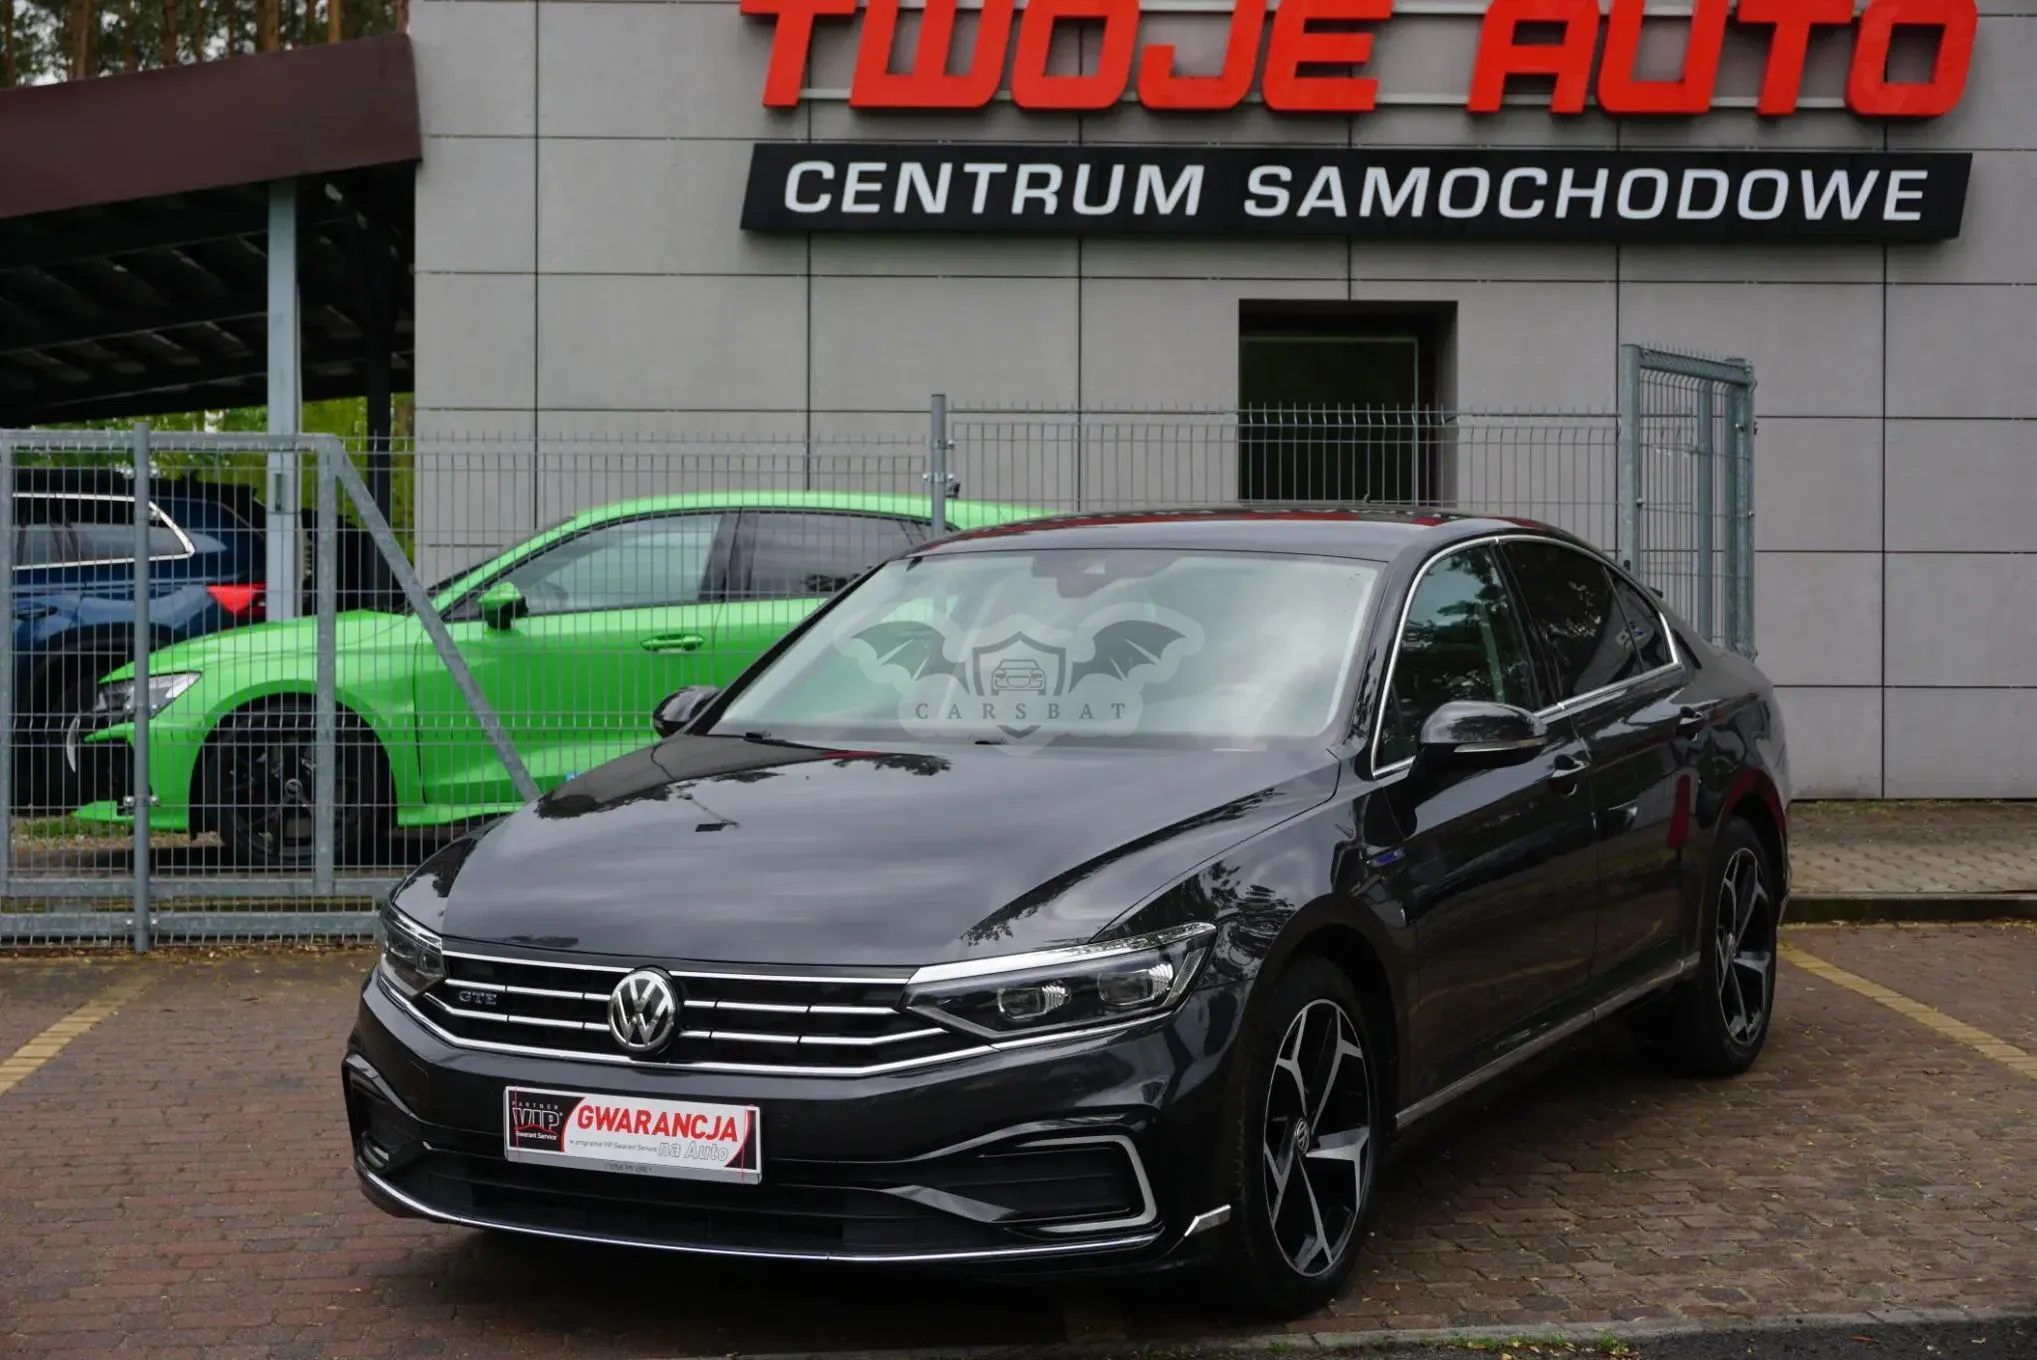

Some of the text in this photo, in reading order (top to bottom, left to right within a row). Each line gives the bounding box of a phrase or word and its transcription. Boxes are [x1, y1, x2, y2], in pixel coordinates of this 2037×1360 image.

[740, 0, 1979, 114] TWOJE AUTO
[784, 160, 1929, 222] CENTRUM SAMOCHODOWE
[458, 991, 497, 1006] GTE
[576, 1105, 738, 1142] GWARANCJA
[659, 1141, 730, 1161] na Auto
